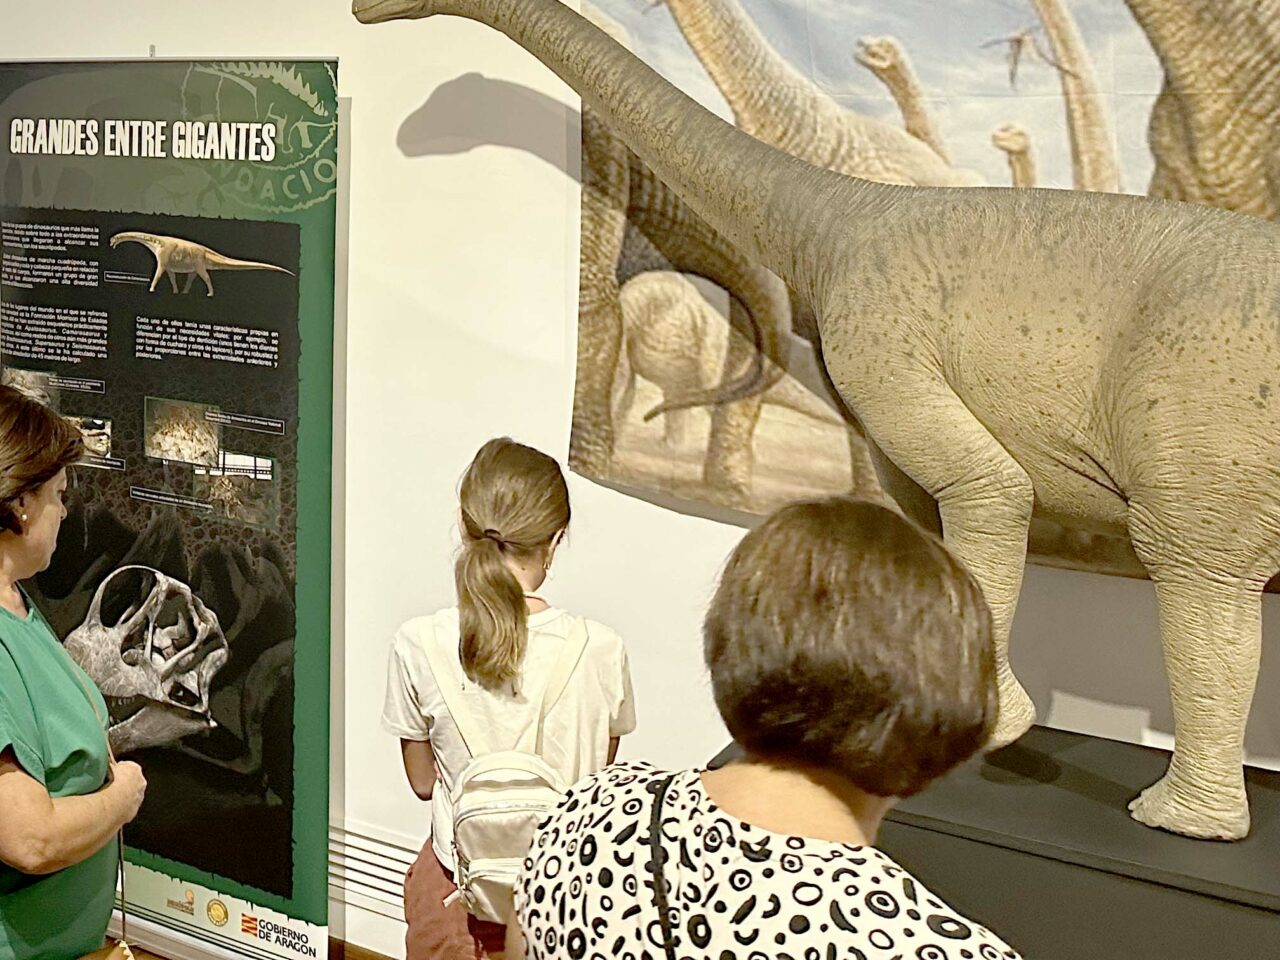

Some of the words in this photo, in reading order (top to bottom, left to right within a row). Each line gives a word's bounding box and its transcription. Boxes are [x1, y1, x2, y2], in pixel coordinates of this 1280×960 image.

[10, 118, 99, 156] GRANDES
[104, 120, 167, 158] ENTRE
[172, 121, 276, 161] GIGANTES
[258, 919, 309, 944] GOBIERNO
[258, 930, 271, 942] DE
